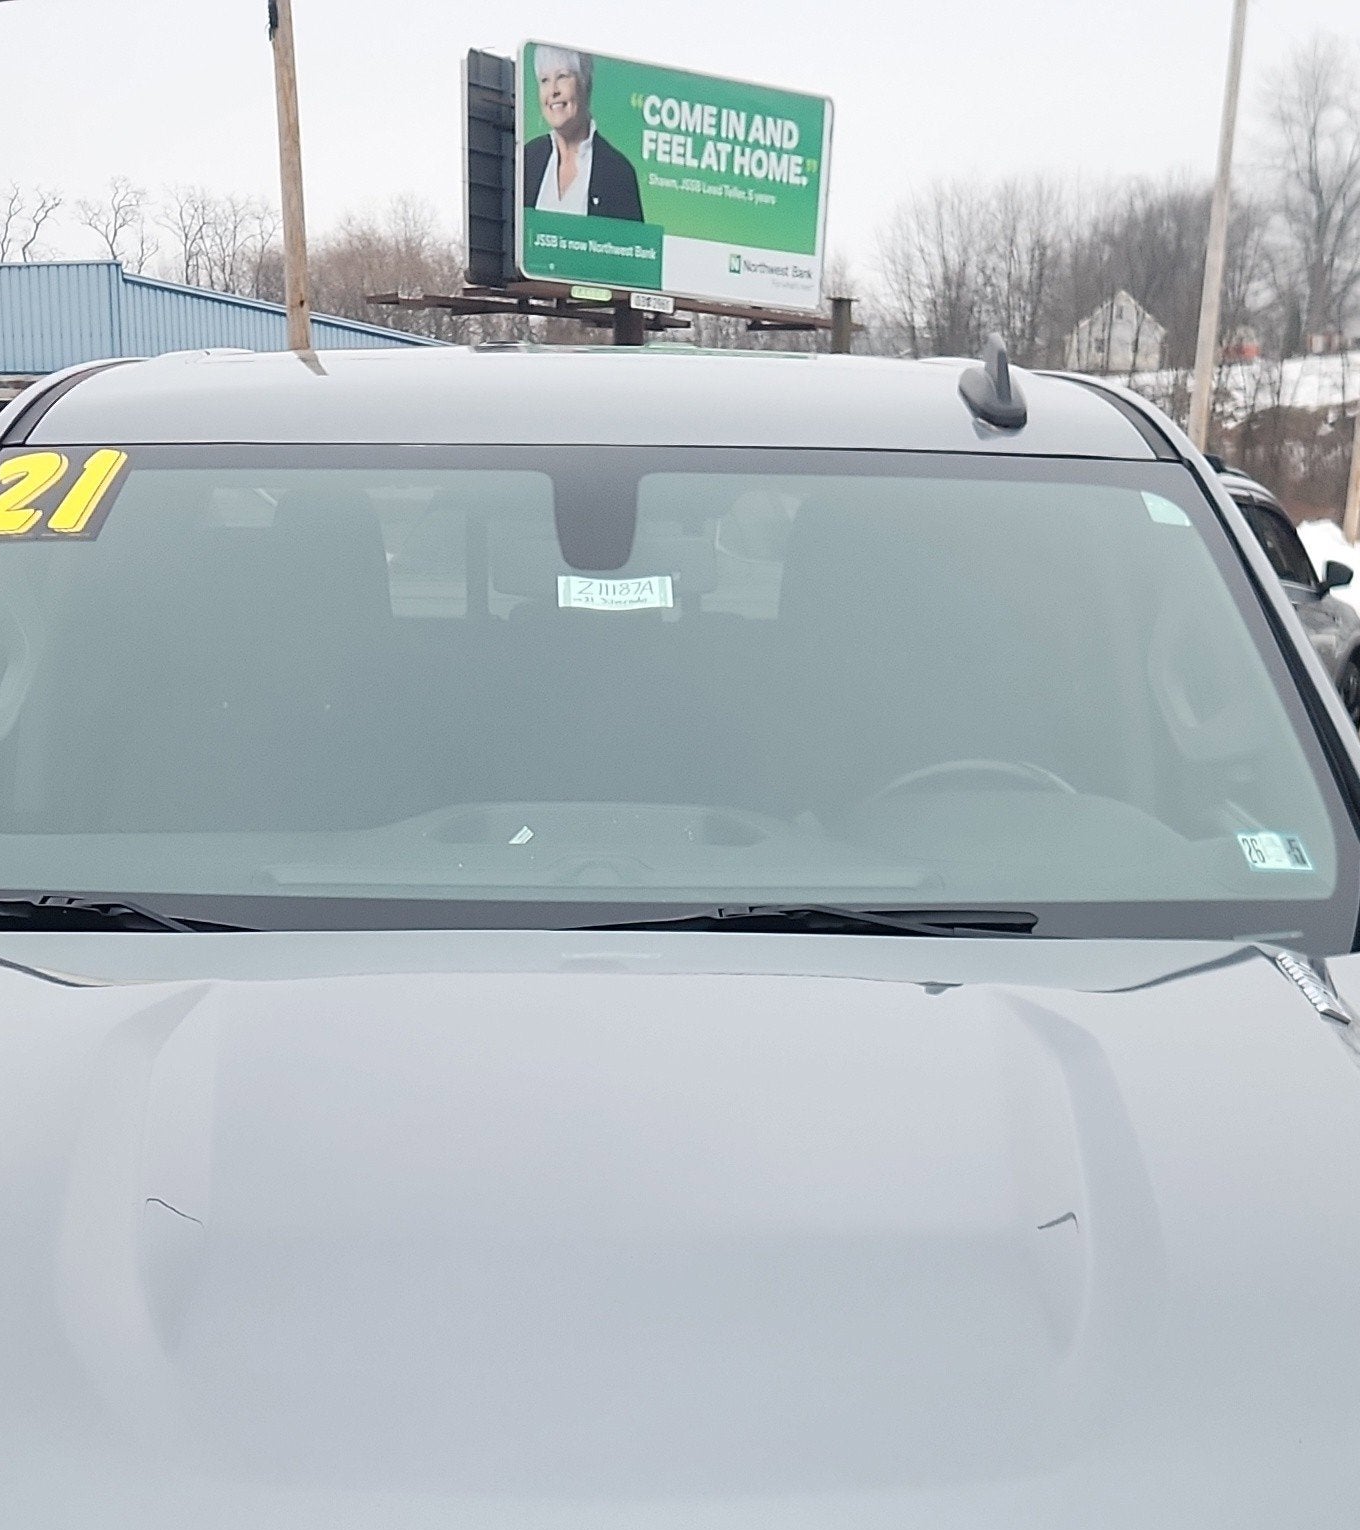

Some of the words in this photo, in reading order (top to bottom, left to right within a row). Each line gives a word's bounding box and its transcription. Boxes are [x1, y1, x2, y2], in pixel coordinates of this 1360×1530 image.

[720, 108, 747, 142] IN
[747, 114, 800, 150] AND
[642, 130, 699, 168] FEEL
[700, 140, 732, 173] AT
[559, 236, 567, 249] is
[568, 240, 588, 251] now
[588, 240, 634, 257] Northwest
[634, 245, 657, 260] Bank
[743, 260, 789, 277] Northwest
[791, 265, 813, 280] Bank
[1241, 837, 1266, 864] 26
